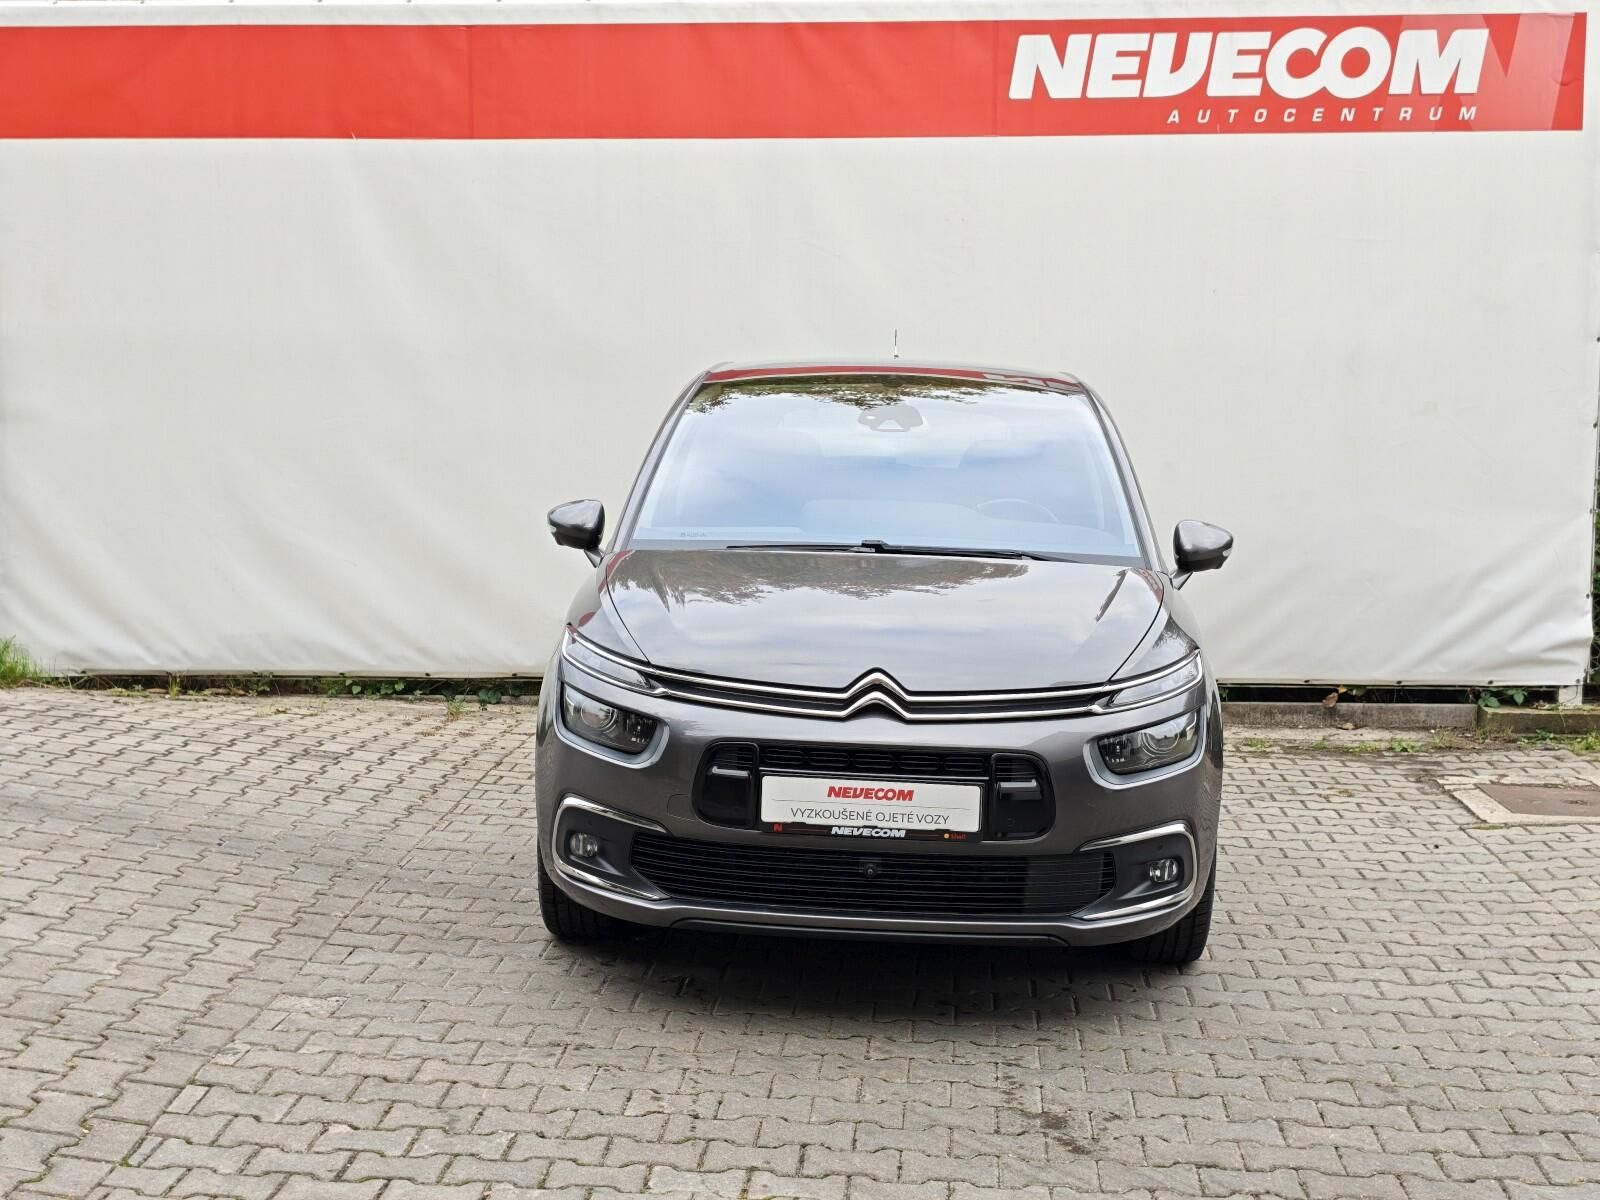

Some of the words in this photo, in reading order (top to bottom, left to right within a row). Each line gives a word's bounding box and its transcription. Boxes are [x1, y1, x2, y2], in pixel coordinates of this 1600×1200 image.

[1008, 26, 1489, 100] NEVECOM
[1167, 106, 1477, 124] AUTOCENTRUM
[827, 785, 914, 802] NEVECOM
[790, 807, 873, 821] VYZKOUŠENÉ
[875, 810, 914, 824] OJETÉ
[916, 813, 950, 825] VOZY
[831, 826, 907, 838] NEVECOM
